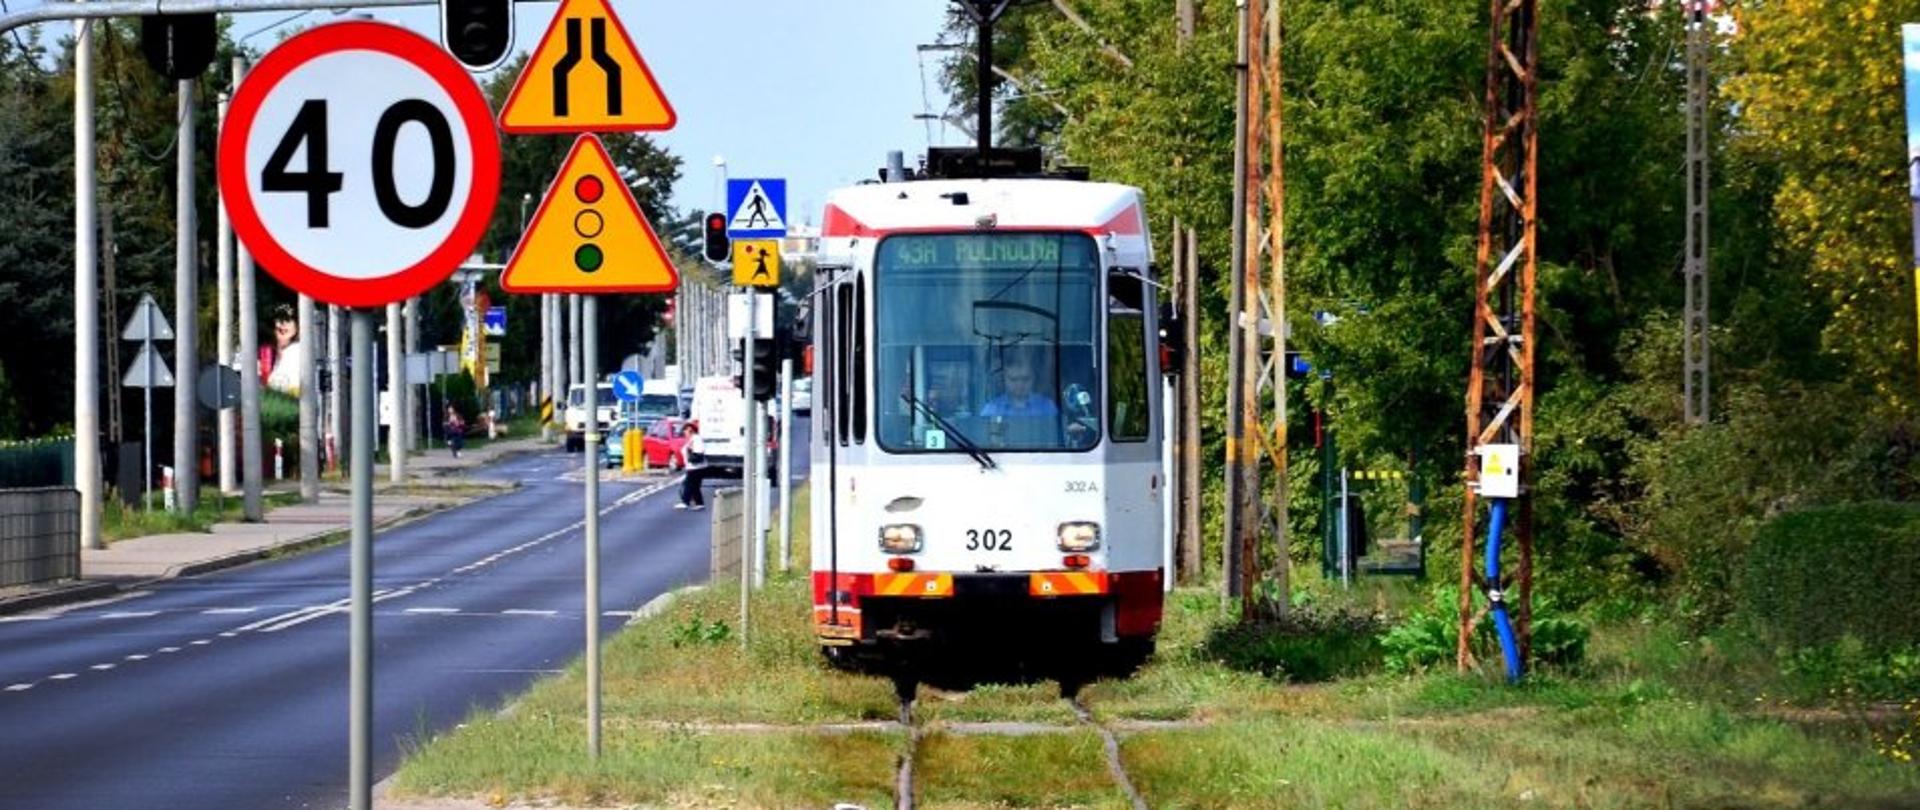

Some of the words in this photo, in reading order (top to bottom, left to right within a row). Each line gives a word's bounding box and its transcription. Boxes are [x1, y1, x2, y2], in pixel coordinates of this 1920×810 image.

[261, 98, 456, 229] 40
[898, 239, 937, 264] 43A
[930, 436, 938, 447] 3
[966, 529, 1013, 552] 302
